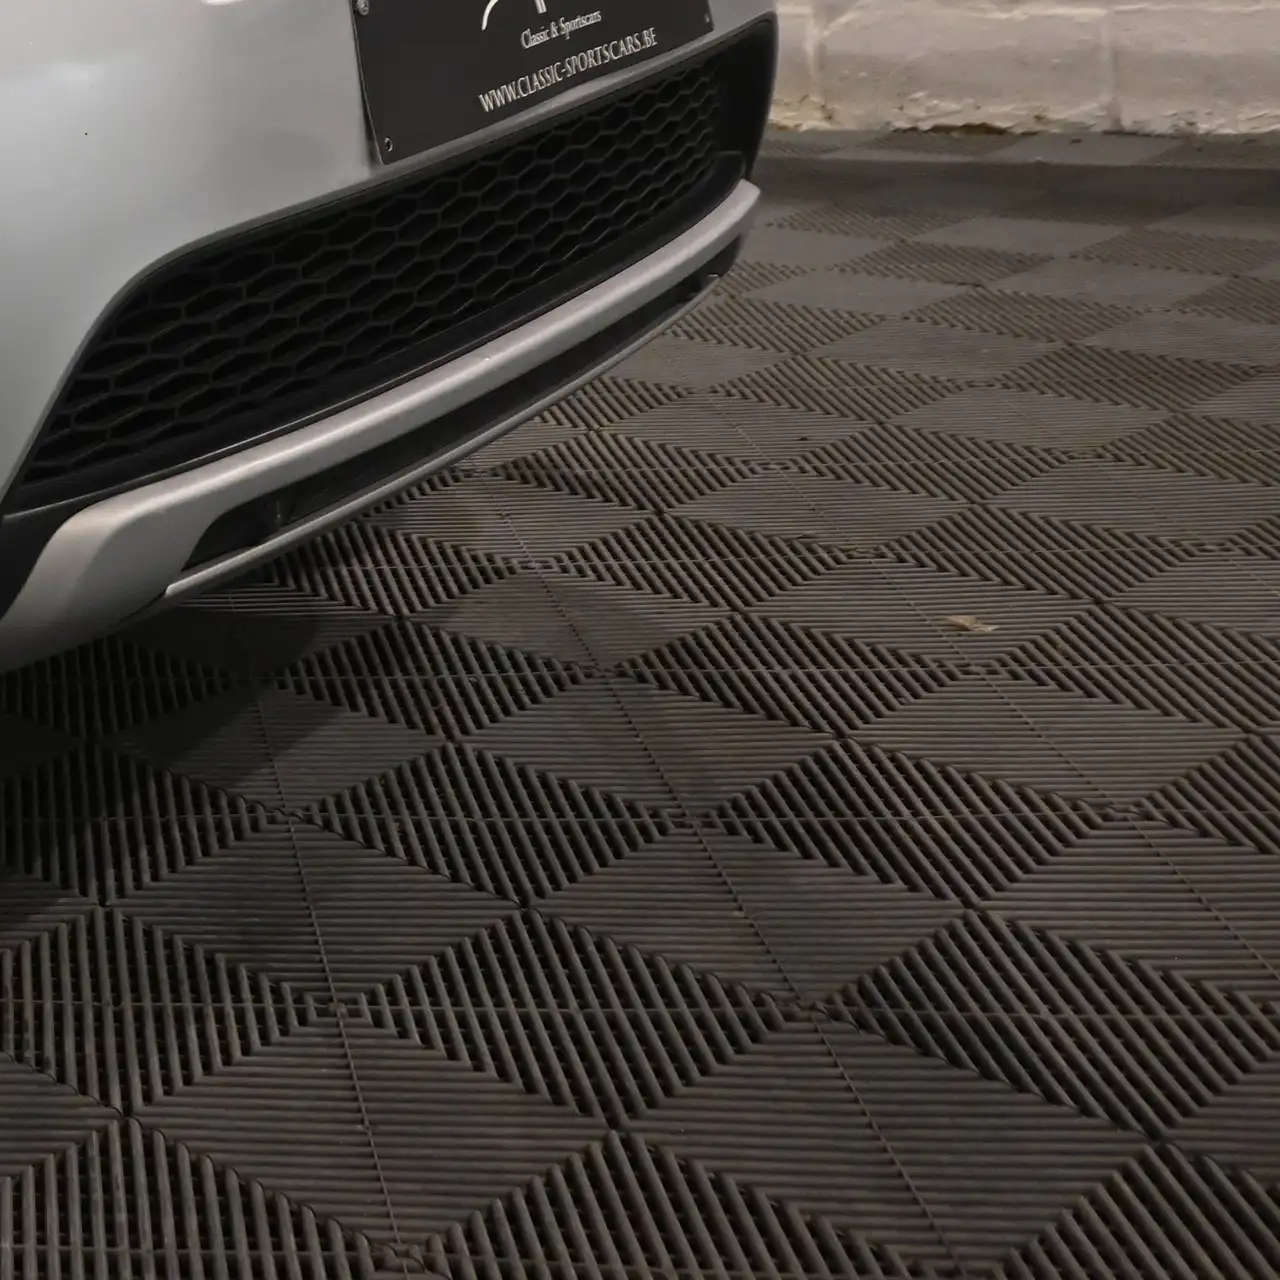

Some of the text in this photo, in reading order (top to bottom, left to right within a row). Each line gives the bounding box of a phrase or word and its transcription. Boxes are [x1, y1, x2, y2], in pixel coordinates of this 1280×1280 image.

[520, 24, 551, 50] Classic
[559, 11, 602, 40] Sportscars
[478, 27, 658, 113] WWW.CLASSIC-SPORTSCARS.BE
